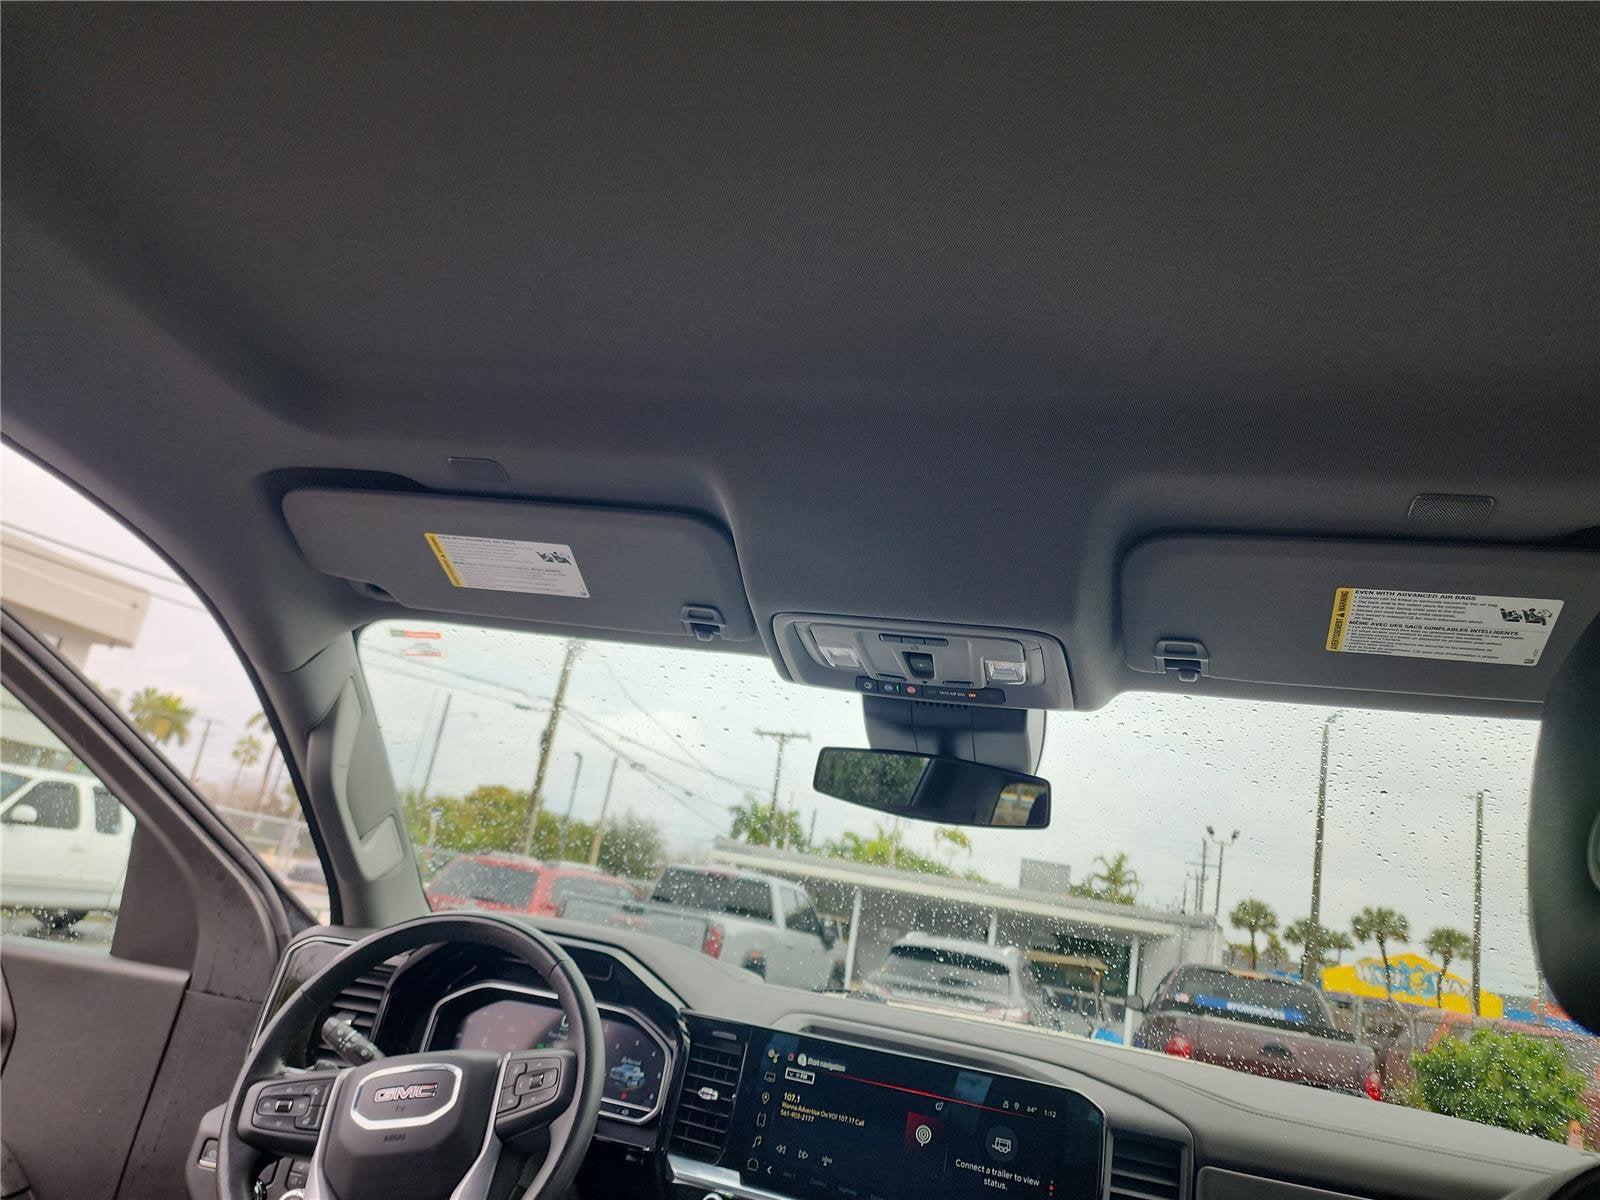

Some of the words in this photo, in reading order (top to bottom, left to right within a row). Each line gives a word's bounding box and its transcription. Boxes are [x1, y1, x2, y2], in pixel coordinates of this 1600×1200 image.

[373, 1082, 439, 1104] GMC
[784, 1092, 801, 1103] 107.1
[955, 1158, 985, 1174] Connect
[992, 1169, 1013, 1180] trailer
[1014, 1174, 1022, 1182] to
[1023, 1176, 1040, 1187] view
[984, 1178, 1008, 1190] status.
